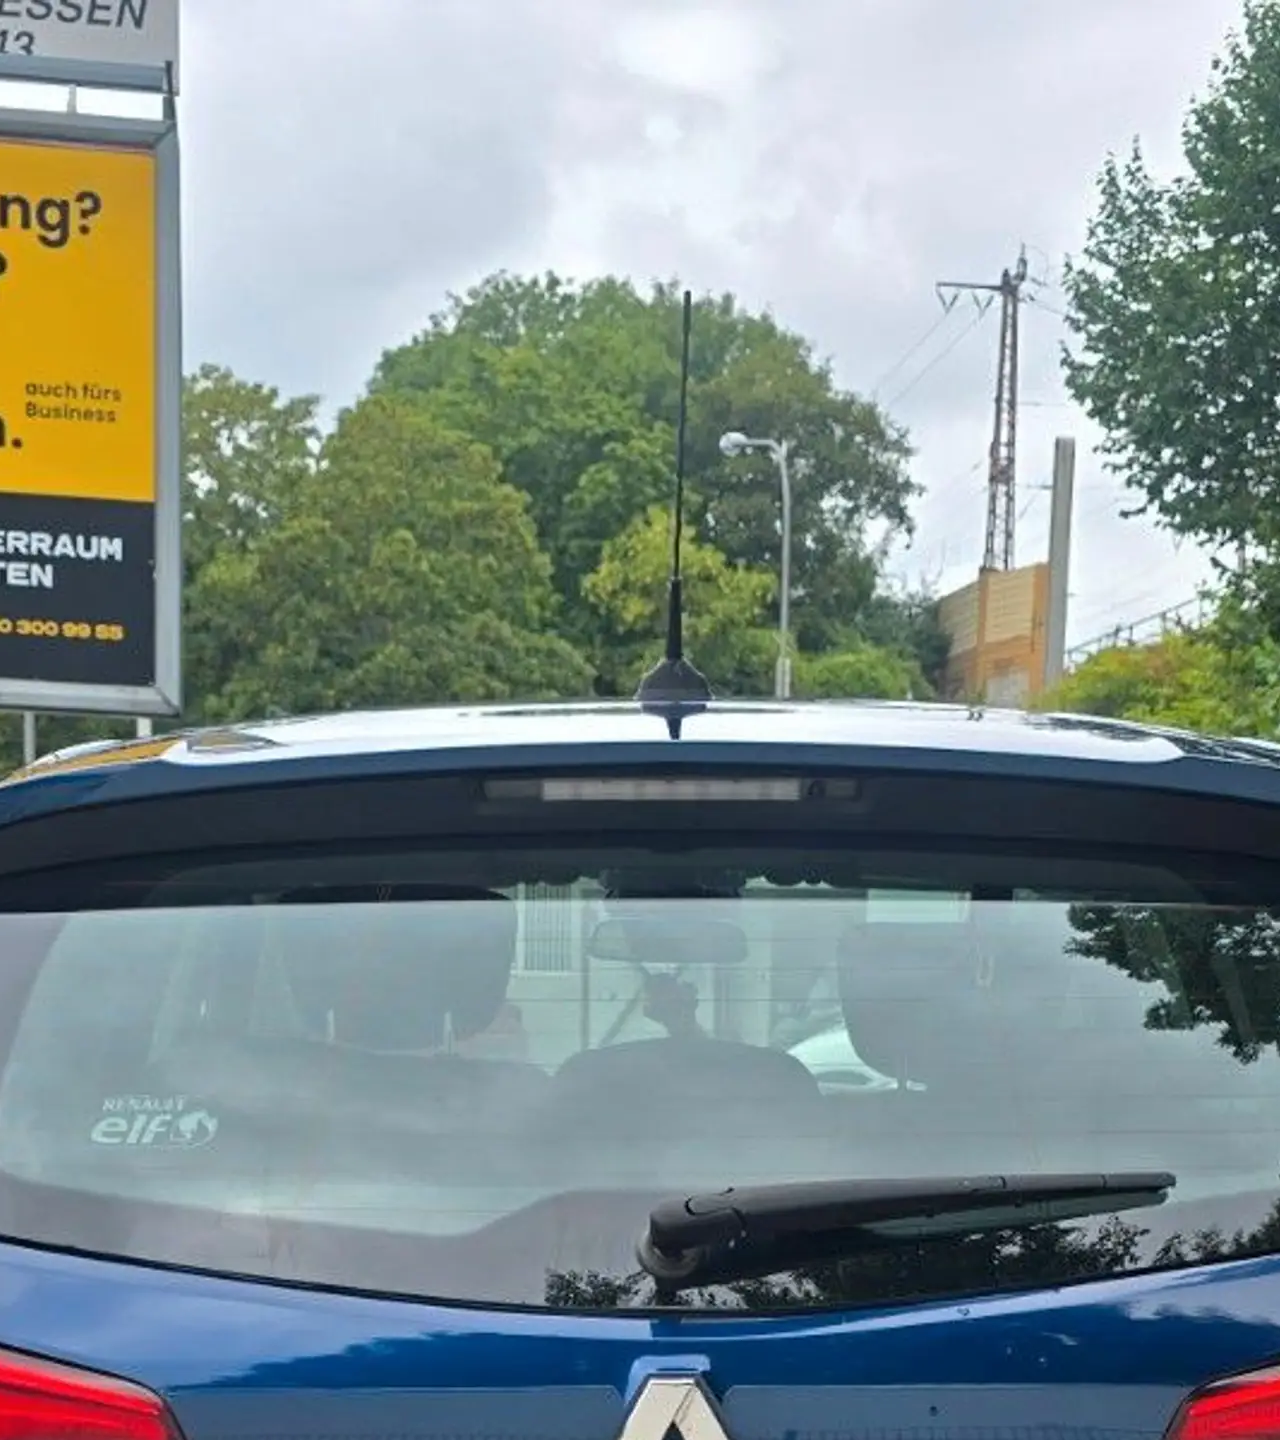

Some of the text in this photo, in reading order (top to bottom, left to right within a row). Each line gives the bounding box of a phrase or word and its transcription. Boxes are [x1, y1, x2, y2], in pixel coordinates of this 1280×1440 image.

[26, 381, 78, 399] auch
[26, 401, 116, 423] Business
[16, 618, 58, 637] 300
[90, 1114, 173, 1144] elf
